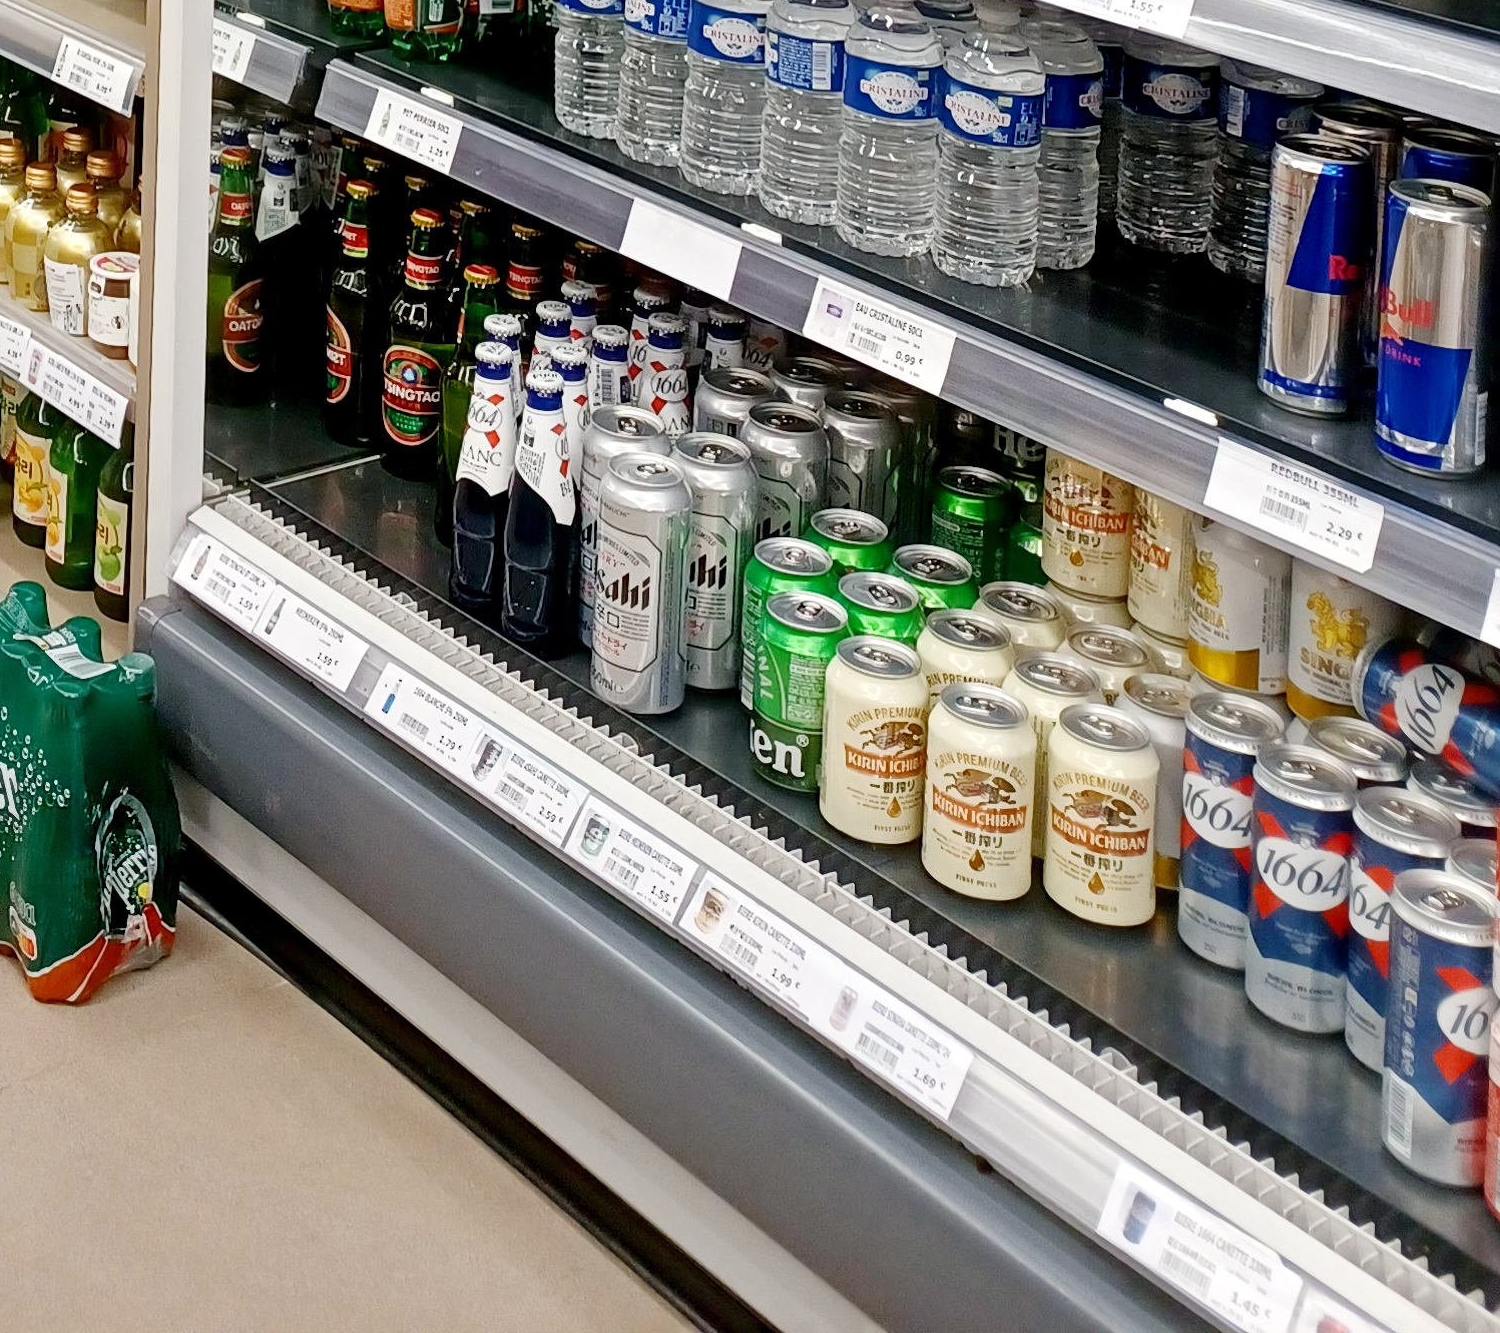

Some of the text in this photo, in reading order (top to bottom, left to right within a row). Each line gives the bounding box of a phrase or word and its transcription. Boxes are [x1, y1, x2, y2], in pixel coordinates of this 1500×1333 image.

[703, 25, 765, 46] CRISTALINE
[861, 81, 928, 100] CRISTALINE
[1143, 83, 1211, 100] CRISTALINE
[402, 107, 436, 130] PET PERRIER
[946, 97, 1011, 126] CRISTALINE
[428, 144, 445, 157] 1.25
[1381, 288, 1435, 329] Bull
[854, 301, 924, 339] EAU CRISTALINE 50CL
[895, 350, 917, 366] 0.99
[384, 378, 441, 404] TSINGTAO
[651, 371, 688, 395] 1664
[1271, 461, 1360, 509] REDBULL 355ML
[1071, 508, 1125, 530] ICHIBAN
[1055, 527, 1102, 549] 一番搾り
[1325, 520, 1354, 541] 2.29
[238, 596, 255, 612] 1.59
[295, 607, 320, 628] HEINEKEN
[316, 651, 334, 667] 1.59
[1400, 663, 1457, 745] 1664
[846, 706, 919, 733] KIRIN PREMIUM
[438, 734, 457, 751] 1.79
[847, 750, 887, 774] KIRIN
[934, 751, 1030, 790] KIRIN PREMIUM BEER
[869, 780, 917, 795] 一番搾り
[1052, 771, 1150, 811] KIRIN PREMIUM BEER
[538, 805, 558, 824] 2.59
[932, 791, 1025, 829] KIRIN ICHIBAN
[1183, 781, 1253, 838] 1664
[951, 829, 1003, 849] 一番搾り
[1052, 813, 1148, 852] KIRIN ICHIBAN
[1070, 850, 1123, 873] 一番搾り
[1263, 847, 1347, 898] 1664
[955, 873, 975, 885] FIRST
[650, 885, 671, 904] 1.55
[1074, 895, 1095, 909] FIRST
[768, 925, 791, 949] CANETTE
[771, 967, 793, 988] 1.99
[913, 1067, 937, 1089] 1.69
[1174, 1210, 1274, 1283] BIERE 1664 CANETTE 330ML
[1230, 1290, 1261, 1318] 1.45
